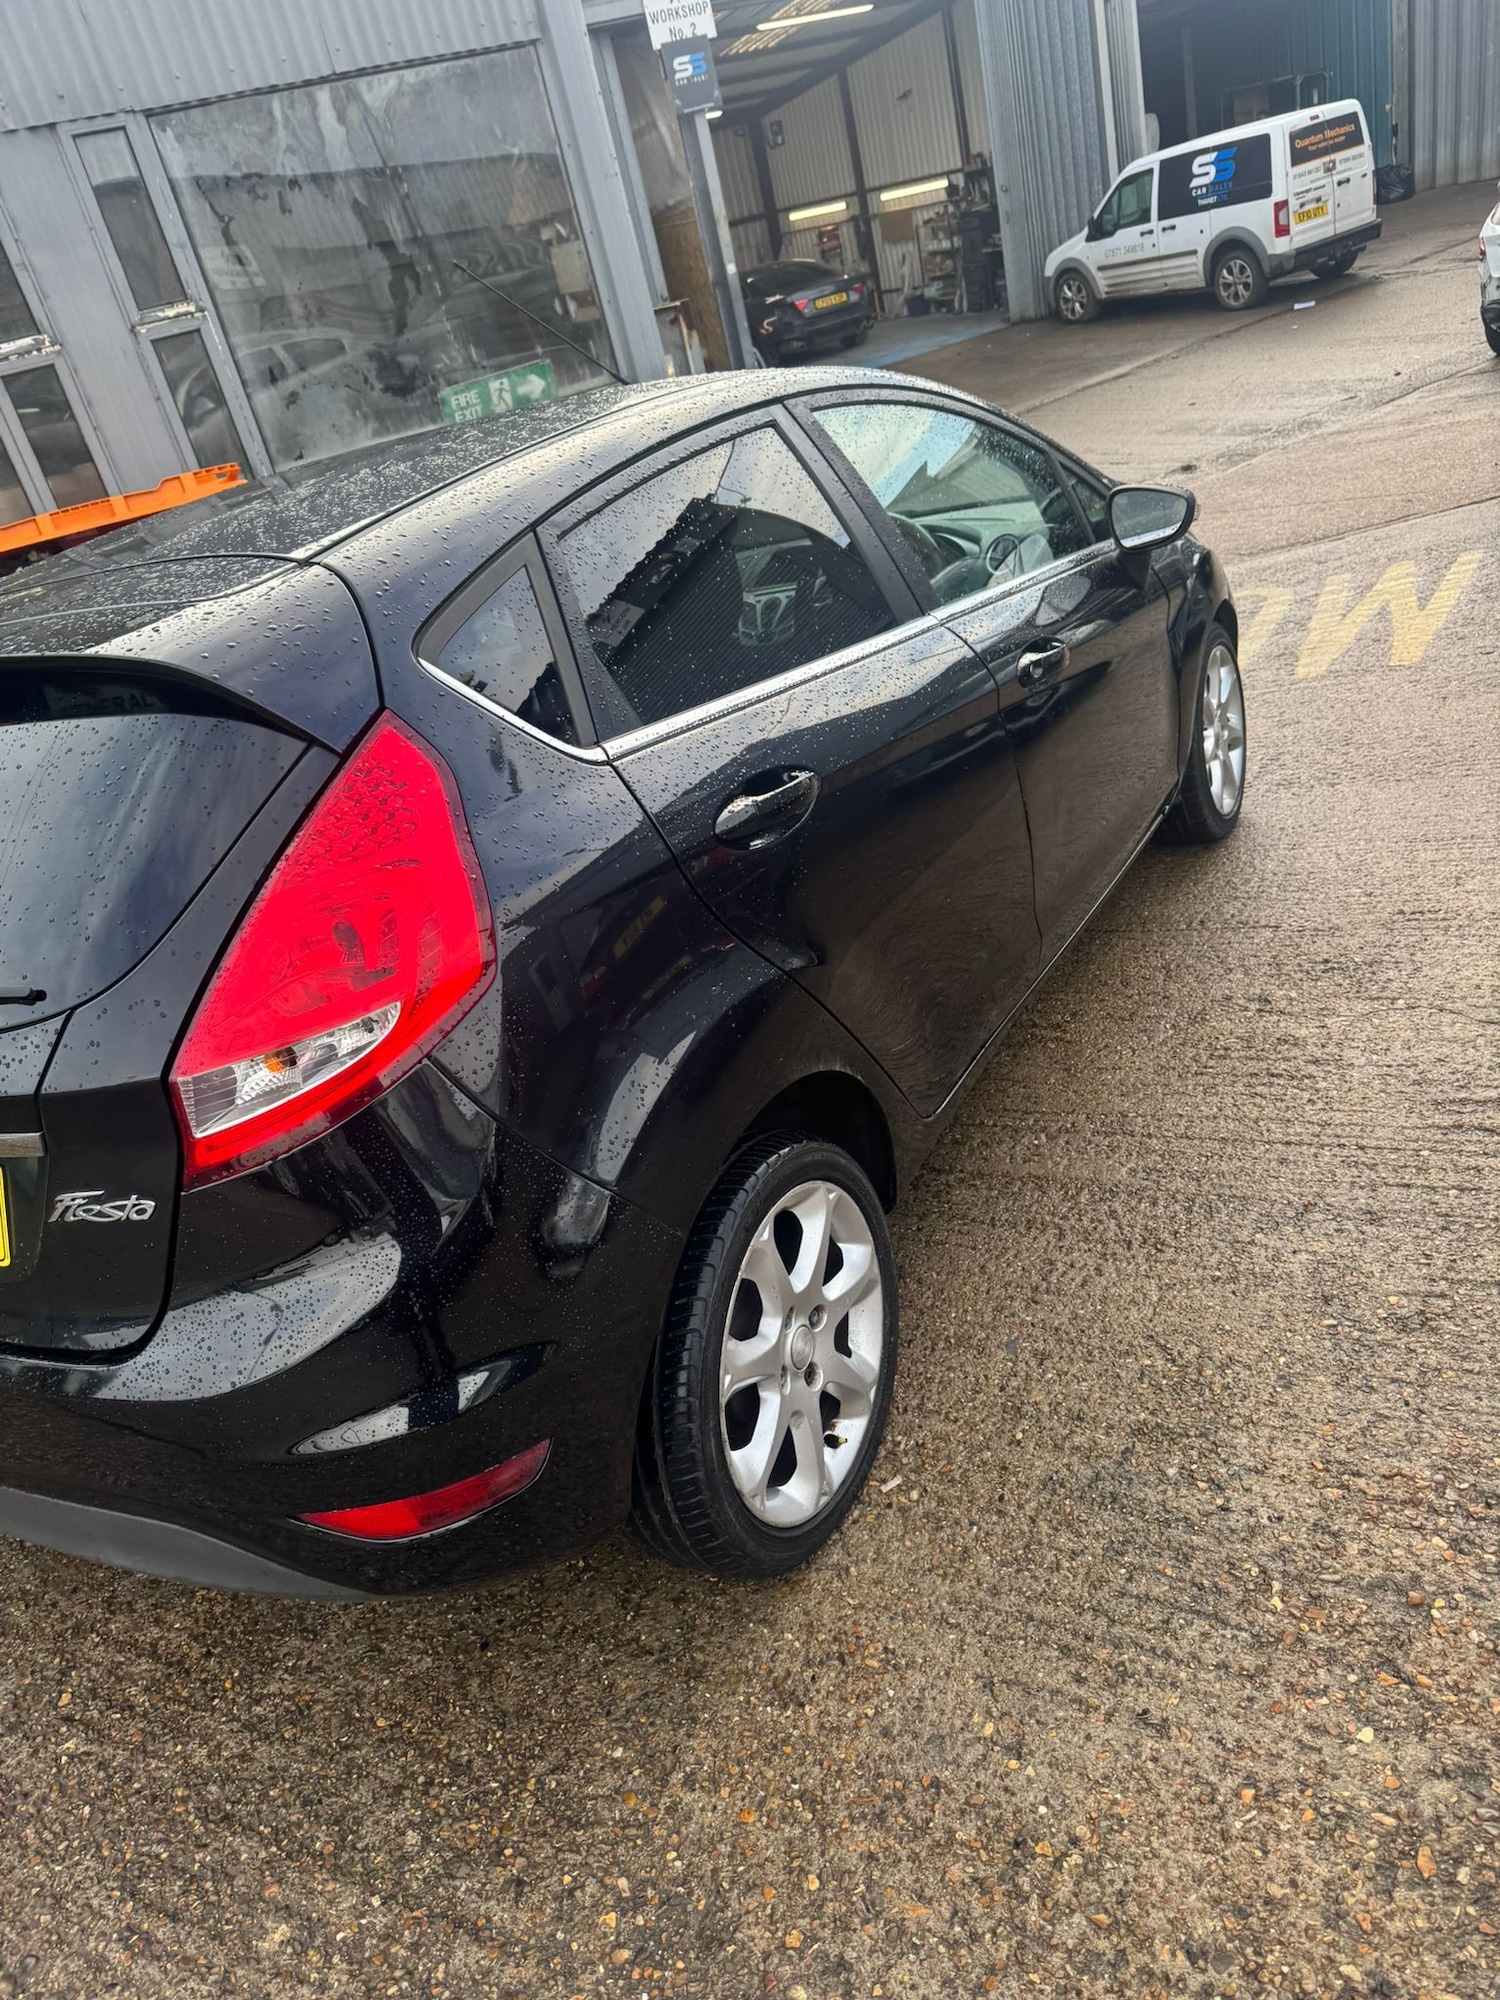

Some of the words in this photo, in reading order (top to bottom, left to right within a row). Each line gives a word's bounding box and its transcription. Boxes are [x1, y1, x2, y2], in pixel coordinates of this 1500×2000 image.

[649, 1, 709, 24] WORKSHOP
[690, 22, 698, 35] 2
[1294, 133, 1324, 149] Quantum
[1324, 123, 1356, 139] Mechanics
[1192, 186, 1207, 196] CAR
[451, 389, 481, 410] FIRE
[454, 404, 482, 422] EXIT
[48, 1190, 156, 1222] Fiesta
